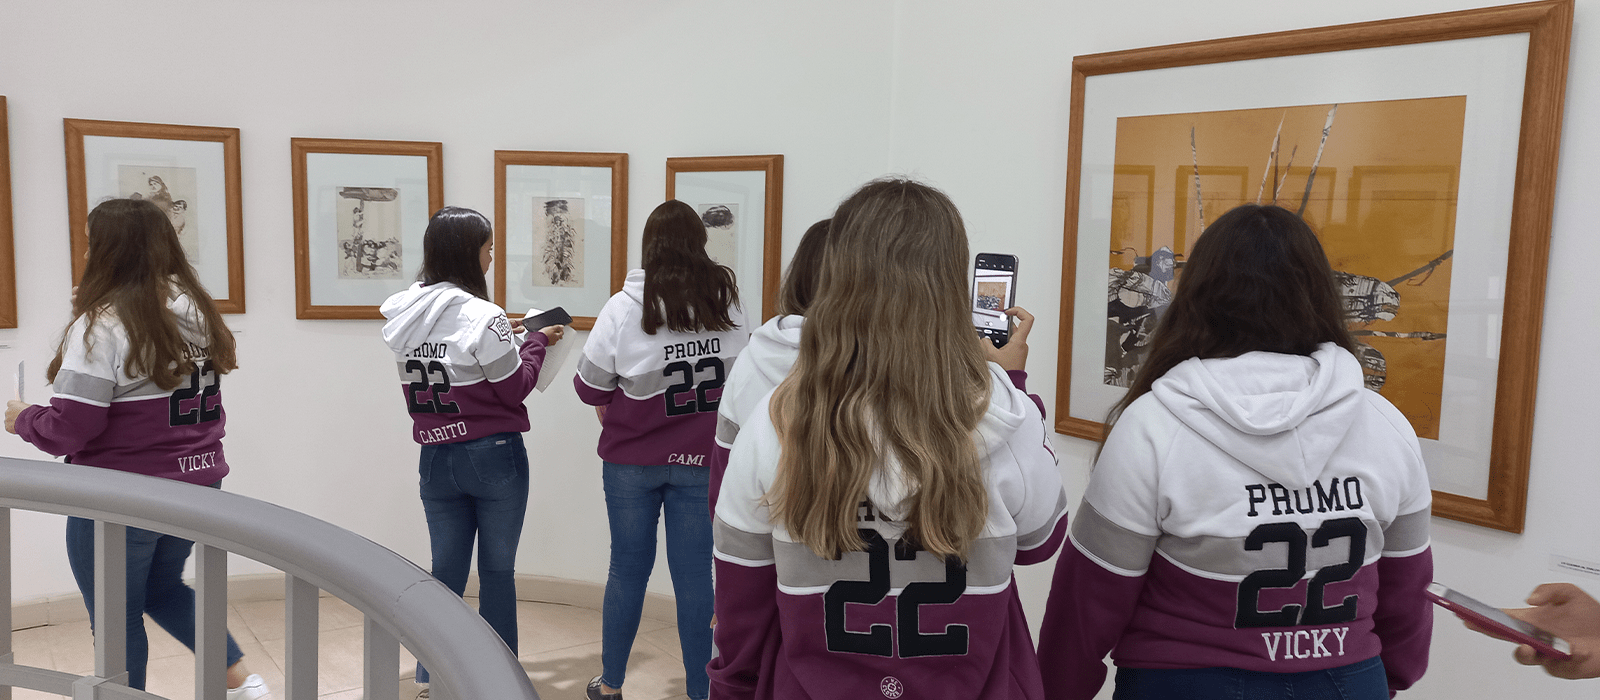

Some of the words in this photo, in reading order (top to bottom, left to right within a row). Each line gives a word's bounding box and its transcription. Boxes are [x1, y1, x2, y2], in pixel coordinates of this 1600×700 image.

[405, 342, 448, 359] ROMO
[664, 337, 721, 361] PROMO
[169, 360, 221, 428] 22
[405, 359, 461, 414] 22
[663, 356, 726, 417] 22
[419, 421, 468, 444] CARITO
[178, 451, 216, 474] VICKY
[667, 453, 706, 467] CAMI
[1244, 476, 1364, 517] PROMO
[1234, 516, 1368, 630] 22
[823, 528, 969, 659] 22
[1261, 626, 1349, 661] VICKY
